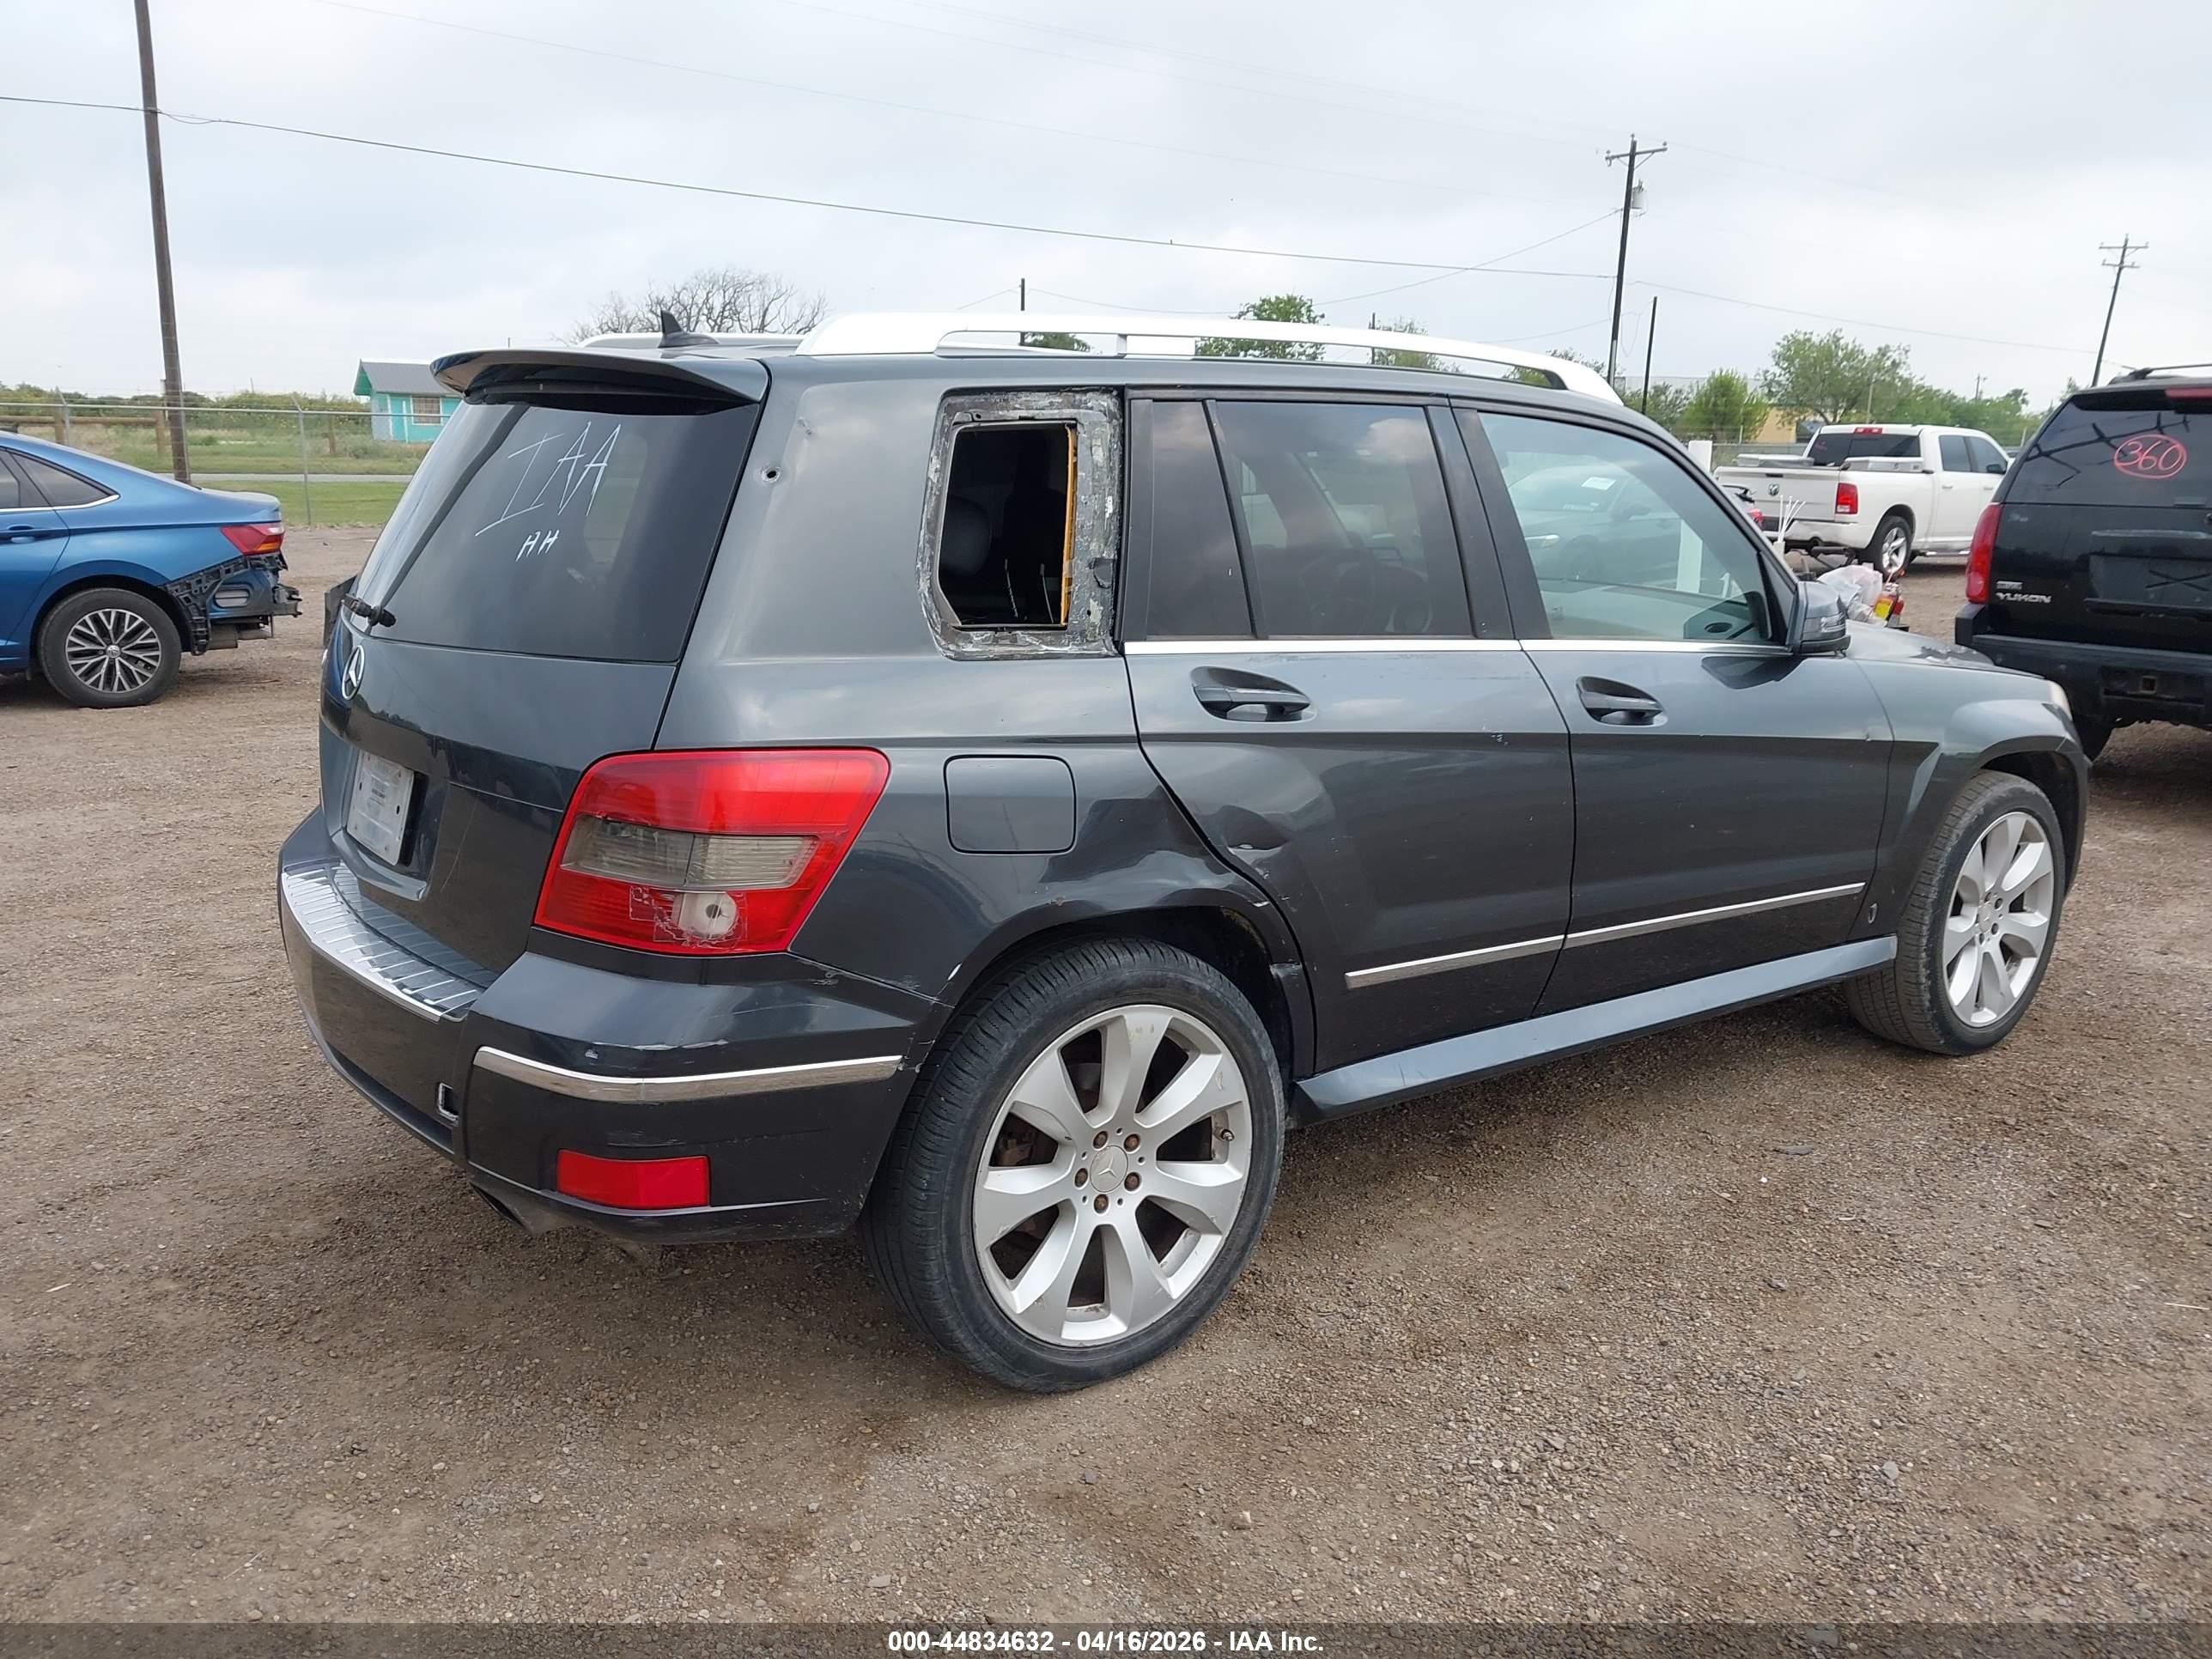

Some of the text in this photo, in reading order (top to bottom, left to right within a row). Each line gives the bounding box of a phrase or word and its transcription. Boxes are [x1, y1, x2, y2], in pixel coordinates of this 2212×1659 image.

[2116, 440, 2182, 471] 360
[475, 420, 622, 537] IAA
[1996, 592, 2051, 604] YUKON
